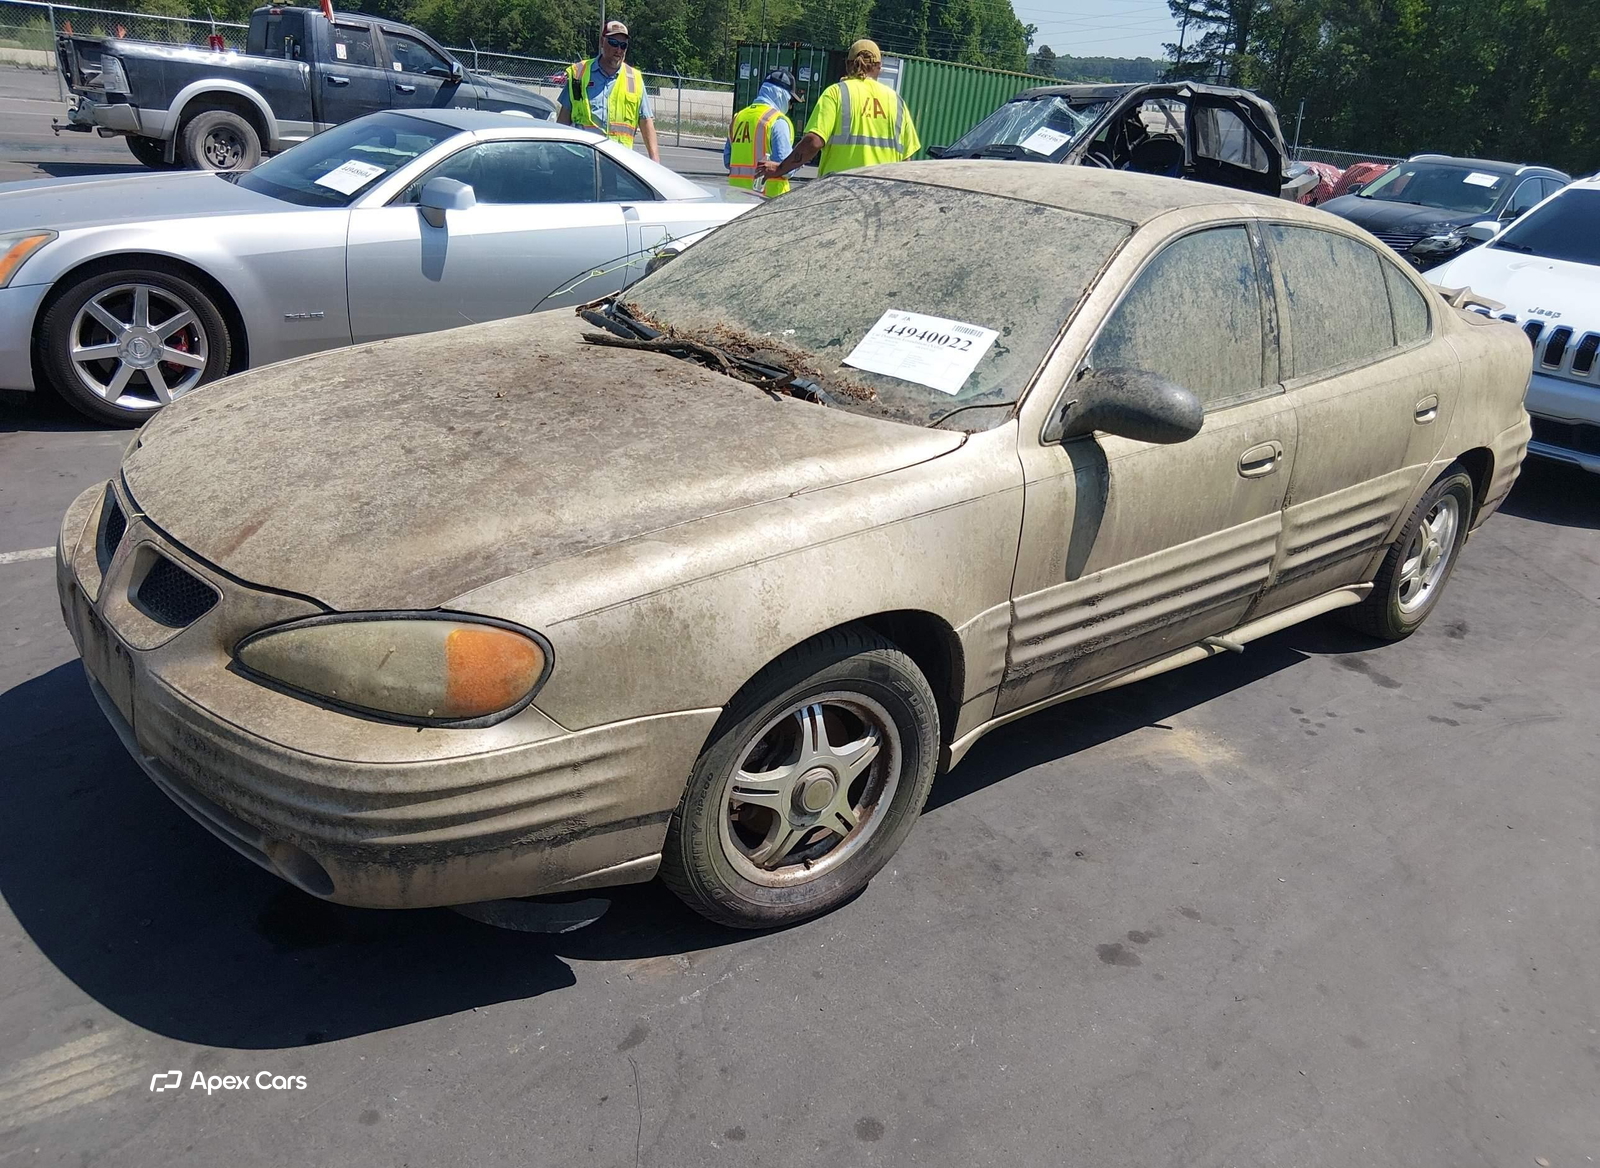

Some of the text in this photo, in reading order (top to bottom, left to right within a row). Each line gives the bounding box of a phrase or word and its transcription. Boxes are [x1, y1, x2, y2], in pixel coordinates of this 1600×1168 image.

[883, 324, 973, 352] 44940022
[1527, 307, 1562, 319] Jeep
[908, 693, 932, 770] DEFINITY
[691, 821, 727, 900] DEFINITY
